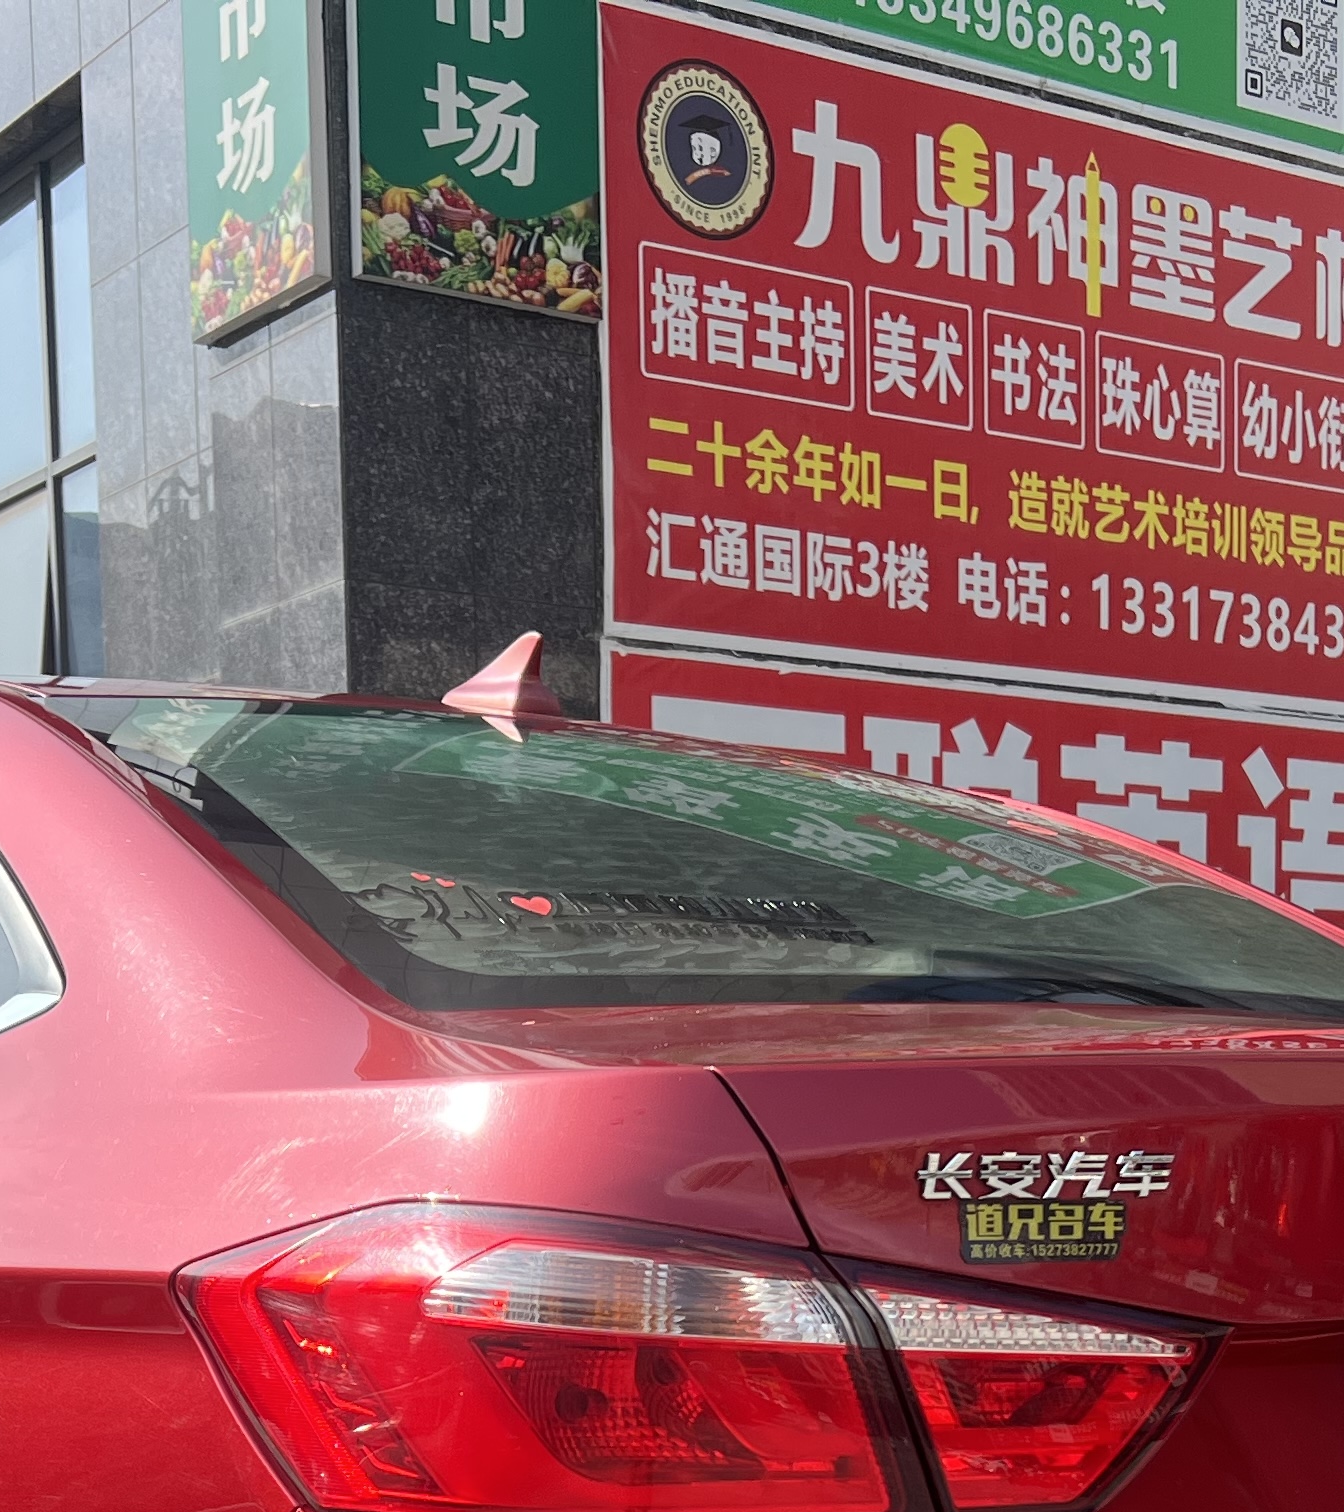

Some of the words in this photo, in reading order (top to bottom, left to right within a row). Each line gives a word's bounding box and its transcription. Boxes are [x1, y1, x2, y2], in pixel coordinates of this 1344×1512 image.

[650, 86, 674, 167] SHENMO
[675, 76, 756, 136] EDUCATION
[751, 146, 762, 180] INT
[650, 266, 847, 386] 播音主持
[873, 310, 964, 404] 美术
[991, 333, 1077, 426] 书法
[1100, 365, 1224, 451] 珠心算
[646, 508, 929, 613] 汇通国际3楼
[917, 1150, 1176, 1200] 长安汽车
[966, 1202, 1125, 1241] 道兄名车
